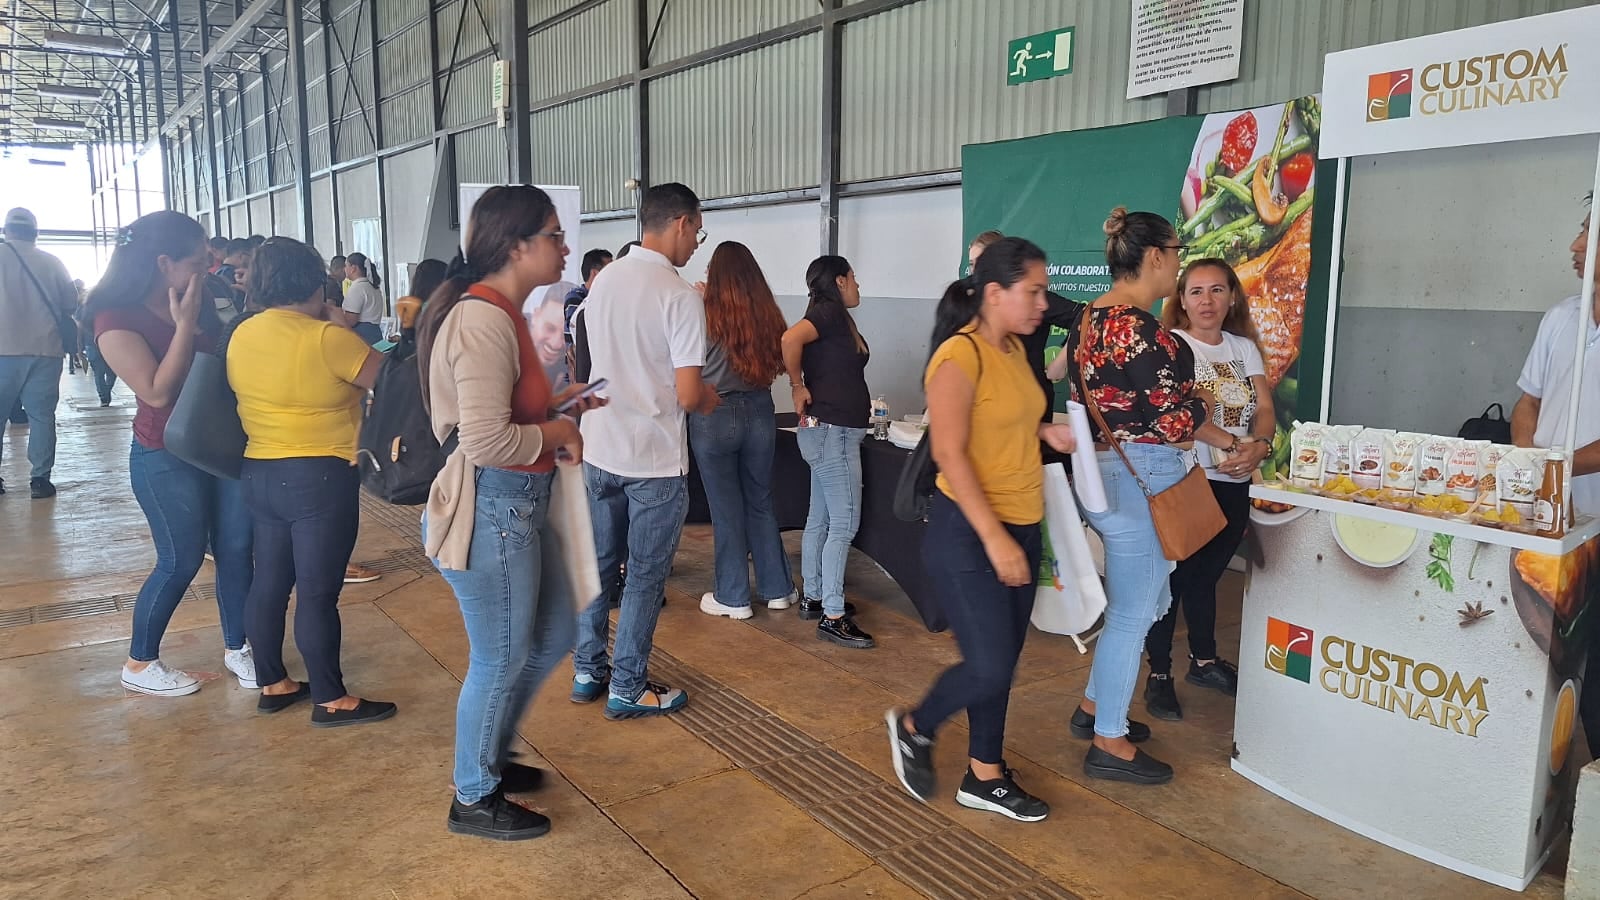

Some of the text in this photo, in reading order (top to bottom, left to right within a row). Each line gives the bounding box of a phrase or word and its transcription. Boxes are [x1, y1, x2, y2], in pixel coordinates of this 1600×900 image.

[1420, 43, 1568, 92] CUSTOM
[1419, 74, 1568, 116] CULINARY
[1060, 265, 1112, 276] COLABORAT
[1078, 282, 1110, 292] nuestro
[1320, 635, 1489, 711] CUSTOM
[1319, 666, 1489, 738] CULINARY
